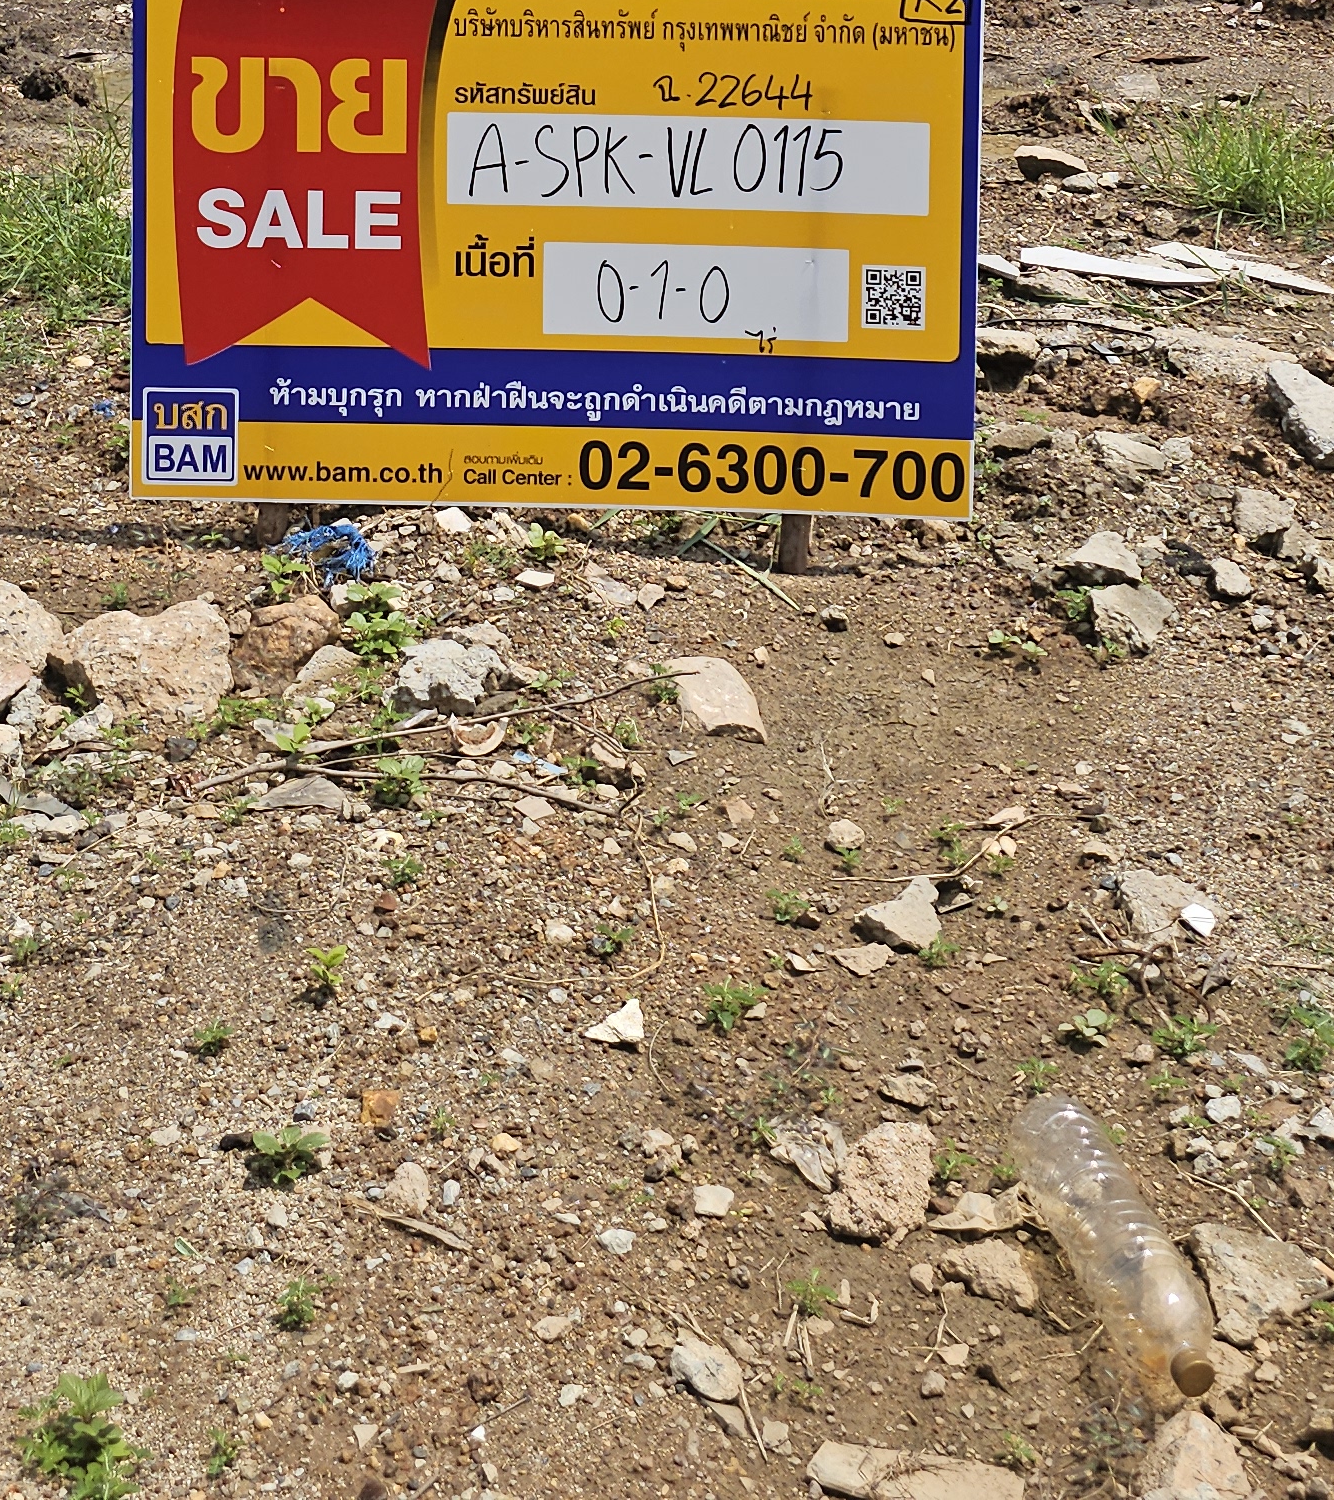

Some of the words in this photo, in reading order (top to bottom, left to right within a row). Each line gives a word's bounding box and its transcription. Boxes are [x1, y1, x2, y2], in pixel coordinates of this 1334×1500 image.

[454, 7, 658, 40] บริษัทบริหารสินทรัพย์
[663, 11, 810, 52] กรุงเทพพาณิชย์
[814, 14, 866, 44] จำกัด
[873, 22, 956, 52] (มหาชน)
[191, 56, 407, 153] ขาย
[454, 82, 596, 106] รหัสทรัพย์สิน
[196, 187, 402, 250] SALE
[454, 234, 535, 278] เนื้อที่
[597, 260, 730, 323] 0-1-0
[154, 400, 228, 431] บสก
[269, 378, 402, 417] ห้ามบุกรุก
[415, 381, 920, 425] หากฝ่าฝืนจะถูกดำเนินคดีตามกฎหมาย
[154, 443, 228, 474] BAM
[243, 461, 443, 485] www.bam.co.th
[464, 468, 496, 485] Call
[502, 469, 562, 486] Center
[579, 440, 966, 502] 02-6300-700
